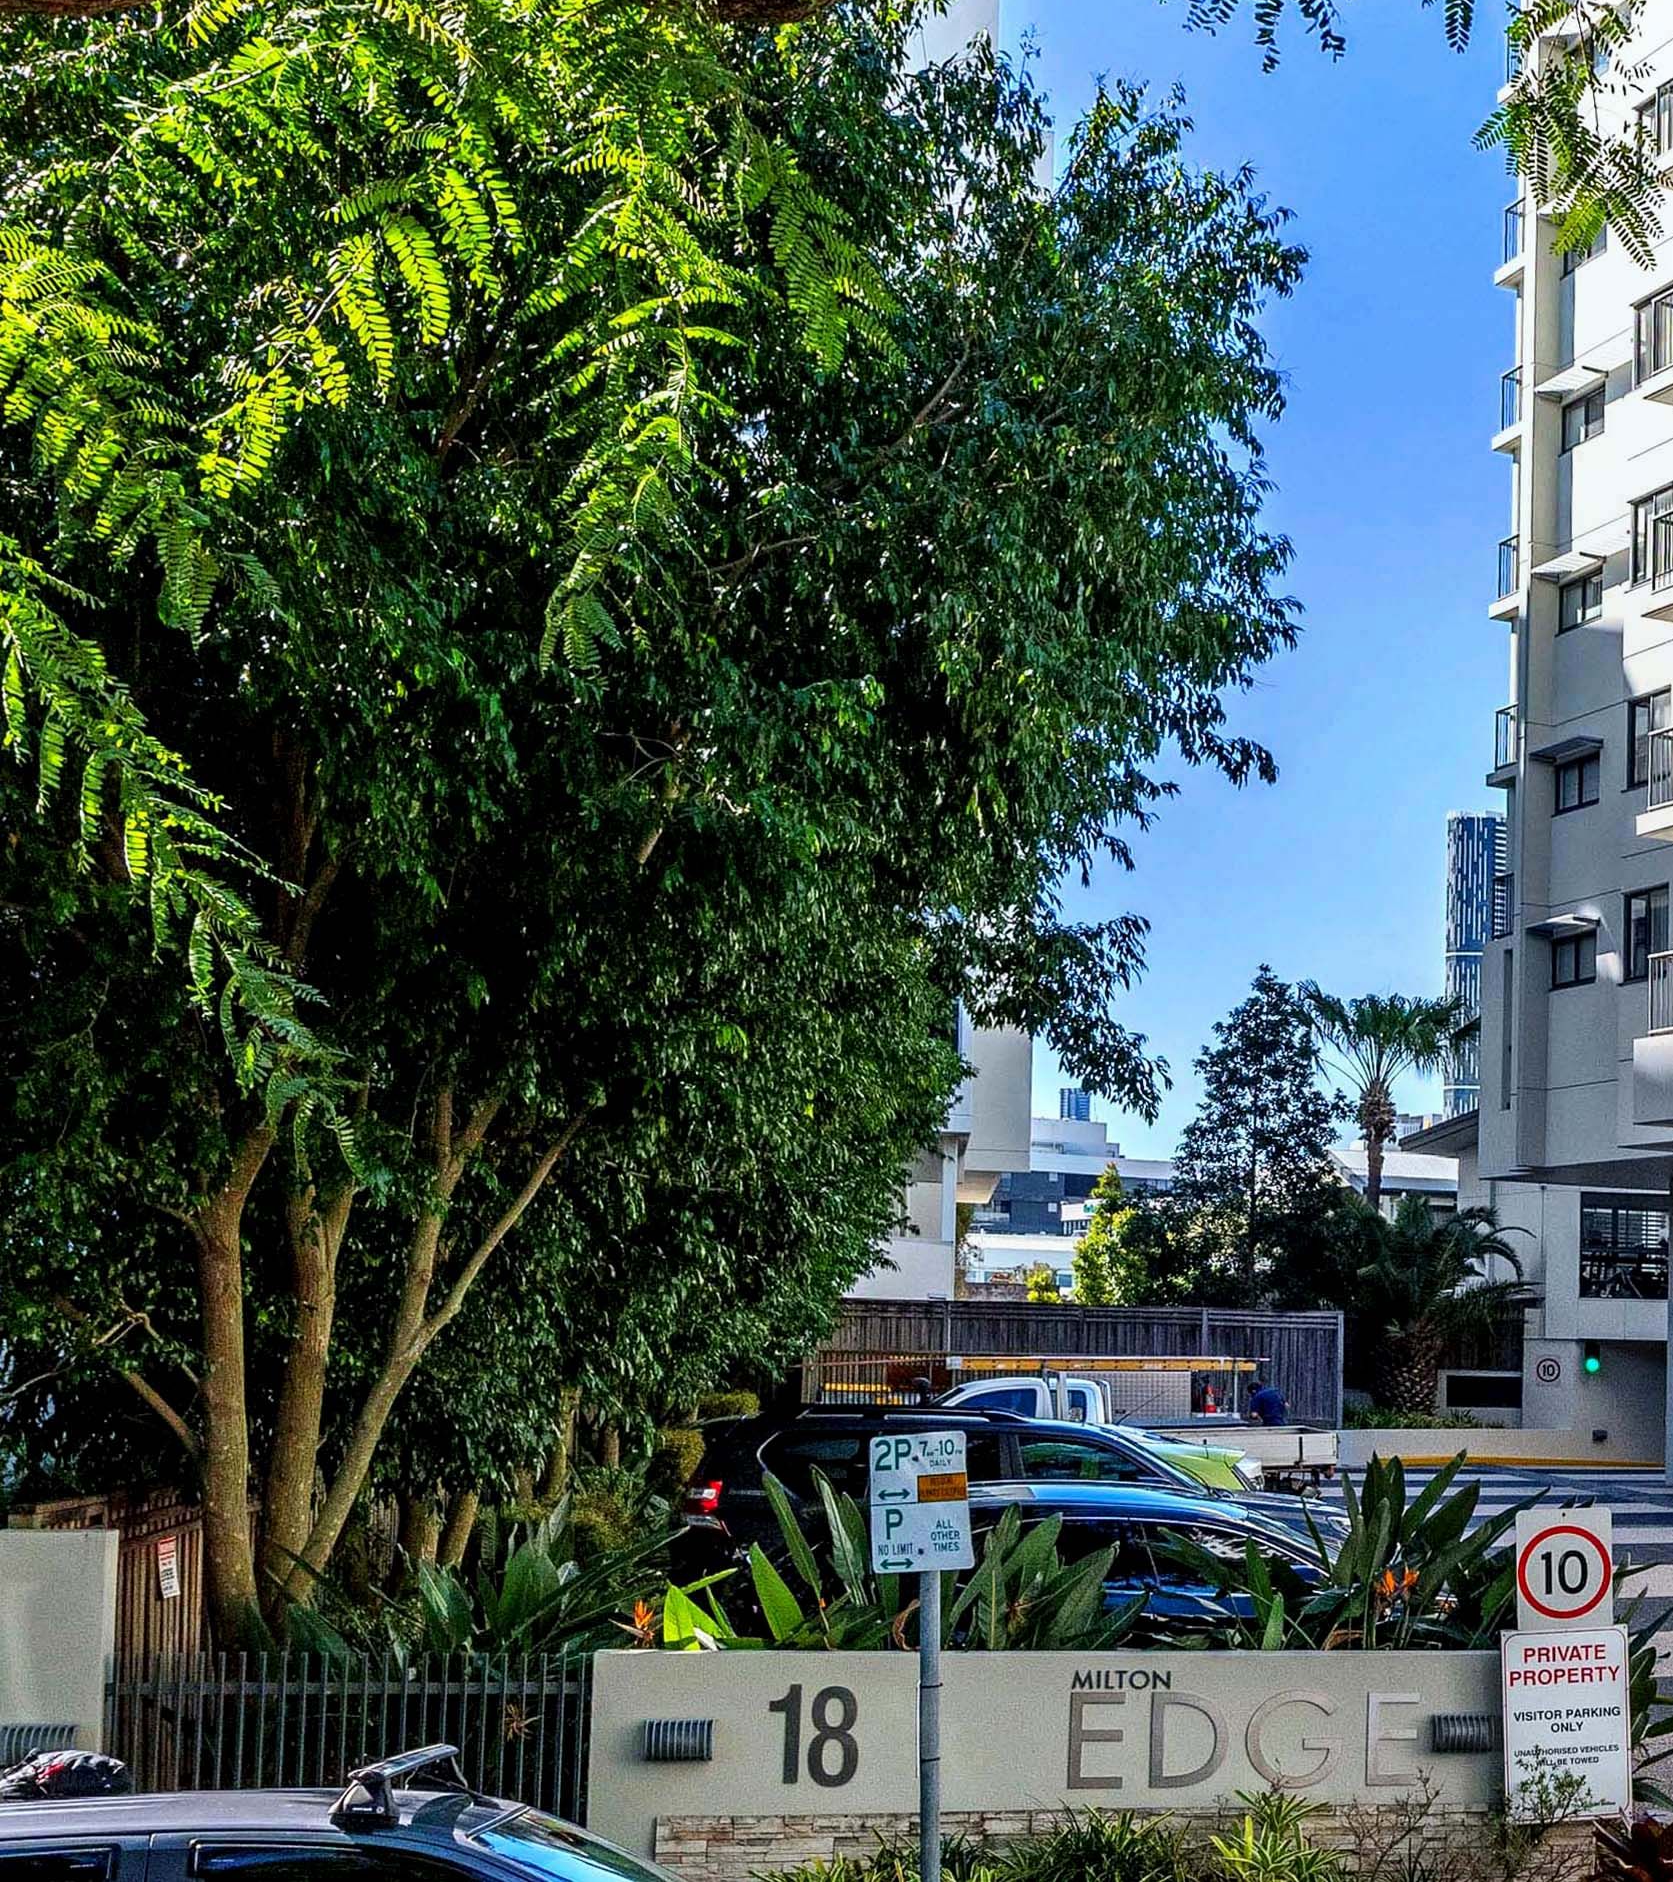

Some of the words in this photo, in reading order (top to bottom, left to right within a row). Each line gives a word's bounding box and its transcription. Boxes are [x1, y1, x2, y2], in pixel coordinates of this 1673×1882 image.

[1542, 1363, 1556, 1377] 10
[875, 1439, 912, 1471] 2P
[885, 1509, 903, 1540] P
[936, 1519, 953, 1530] ALL
[930, 1529, 961, 1541] OTHER
[878, 1544, 890, 1556] NO
[892, 1542, 913, 1555] LIMIT
[933, 1541, 961, 1552] TIMES
[1540, 1549, 1588, 1595] 10
[1523, 1644, 1607, 1664] PRIVATE
[1071, 1669, 1172, 1690] MILTON
[1509, 1665, 1620, 1687] PROPERTY
[1513, 1709, 1562, 1722] VISITOR
[1566, 1706, 1621, 1718] PARKING
[1550, 1721, 1584, 1733] ONLY
[768, 1683, 860, 1788] 18
[1066, 1689, 1421, 1790] EDGE
[1580, 1744, 1620, 1754] VEHICLES
[1556, 1757, 1568, 1766] BE
[1570, 1756, 1599, 1765] TOWED
